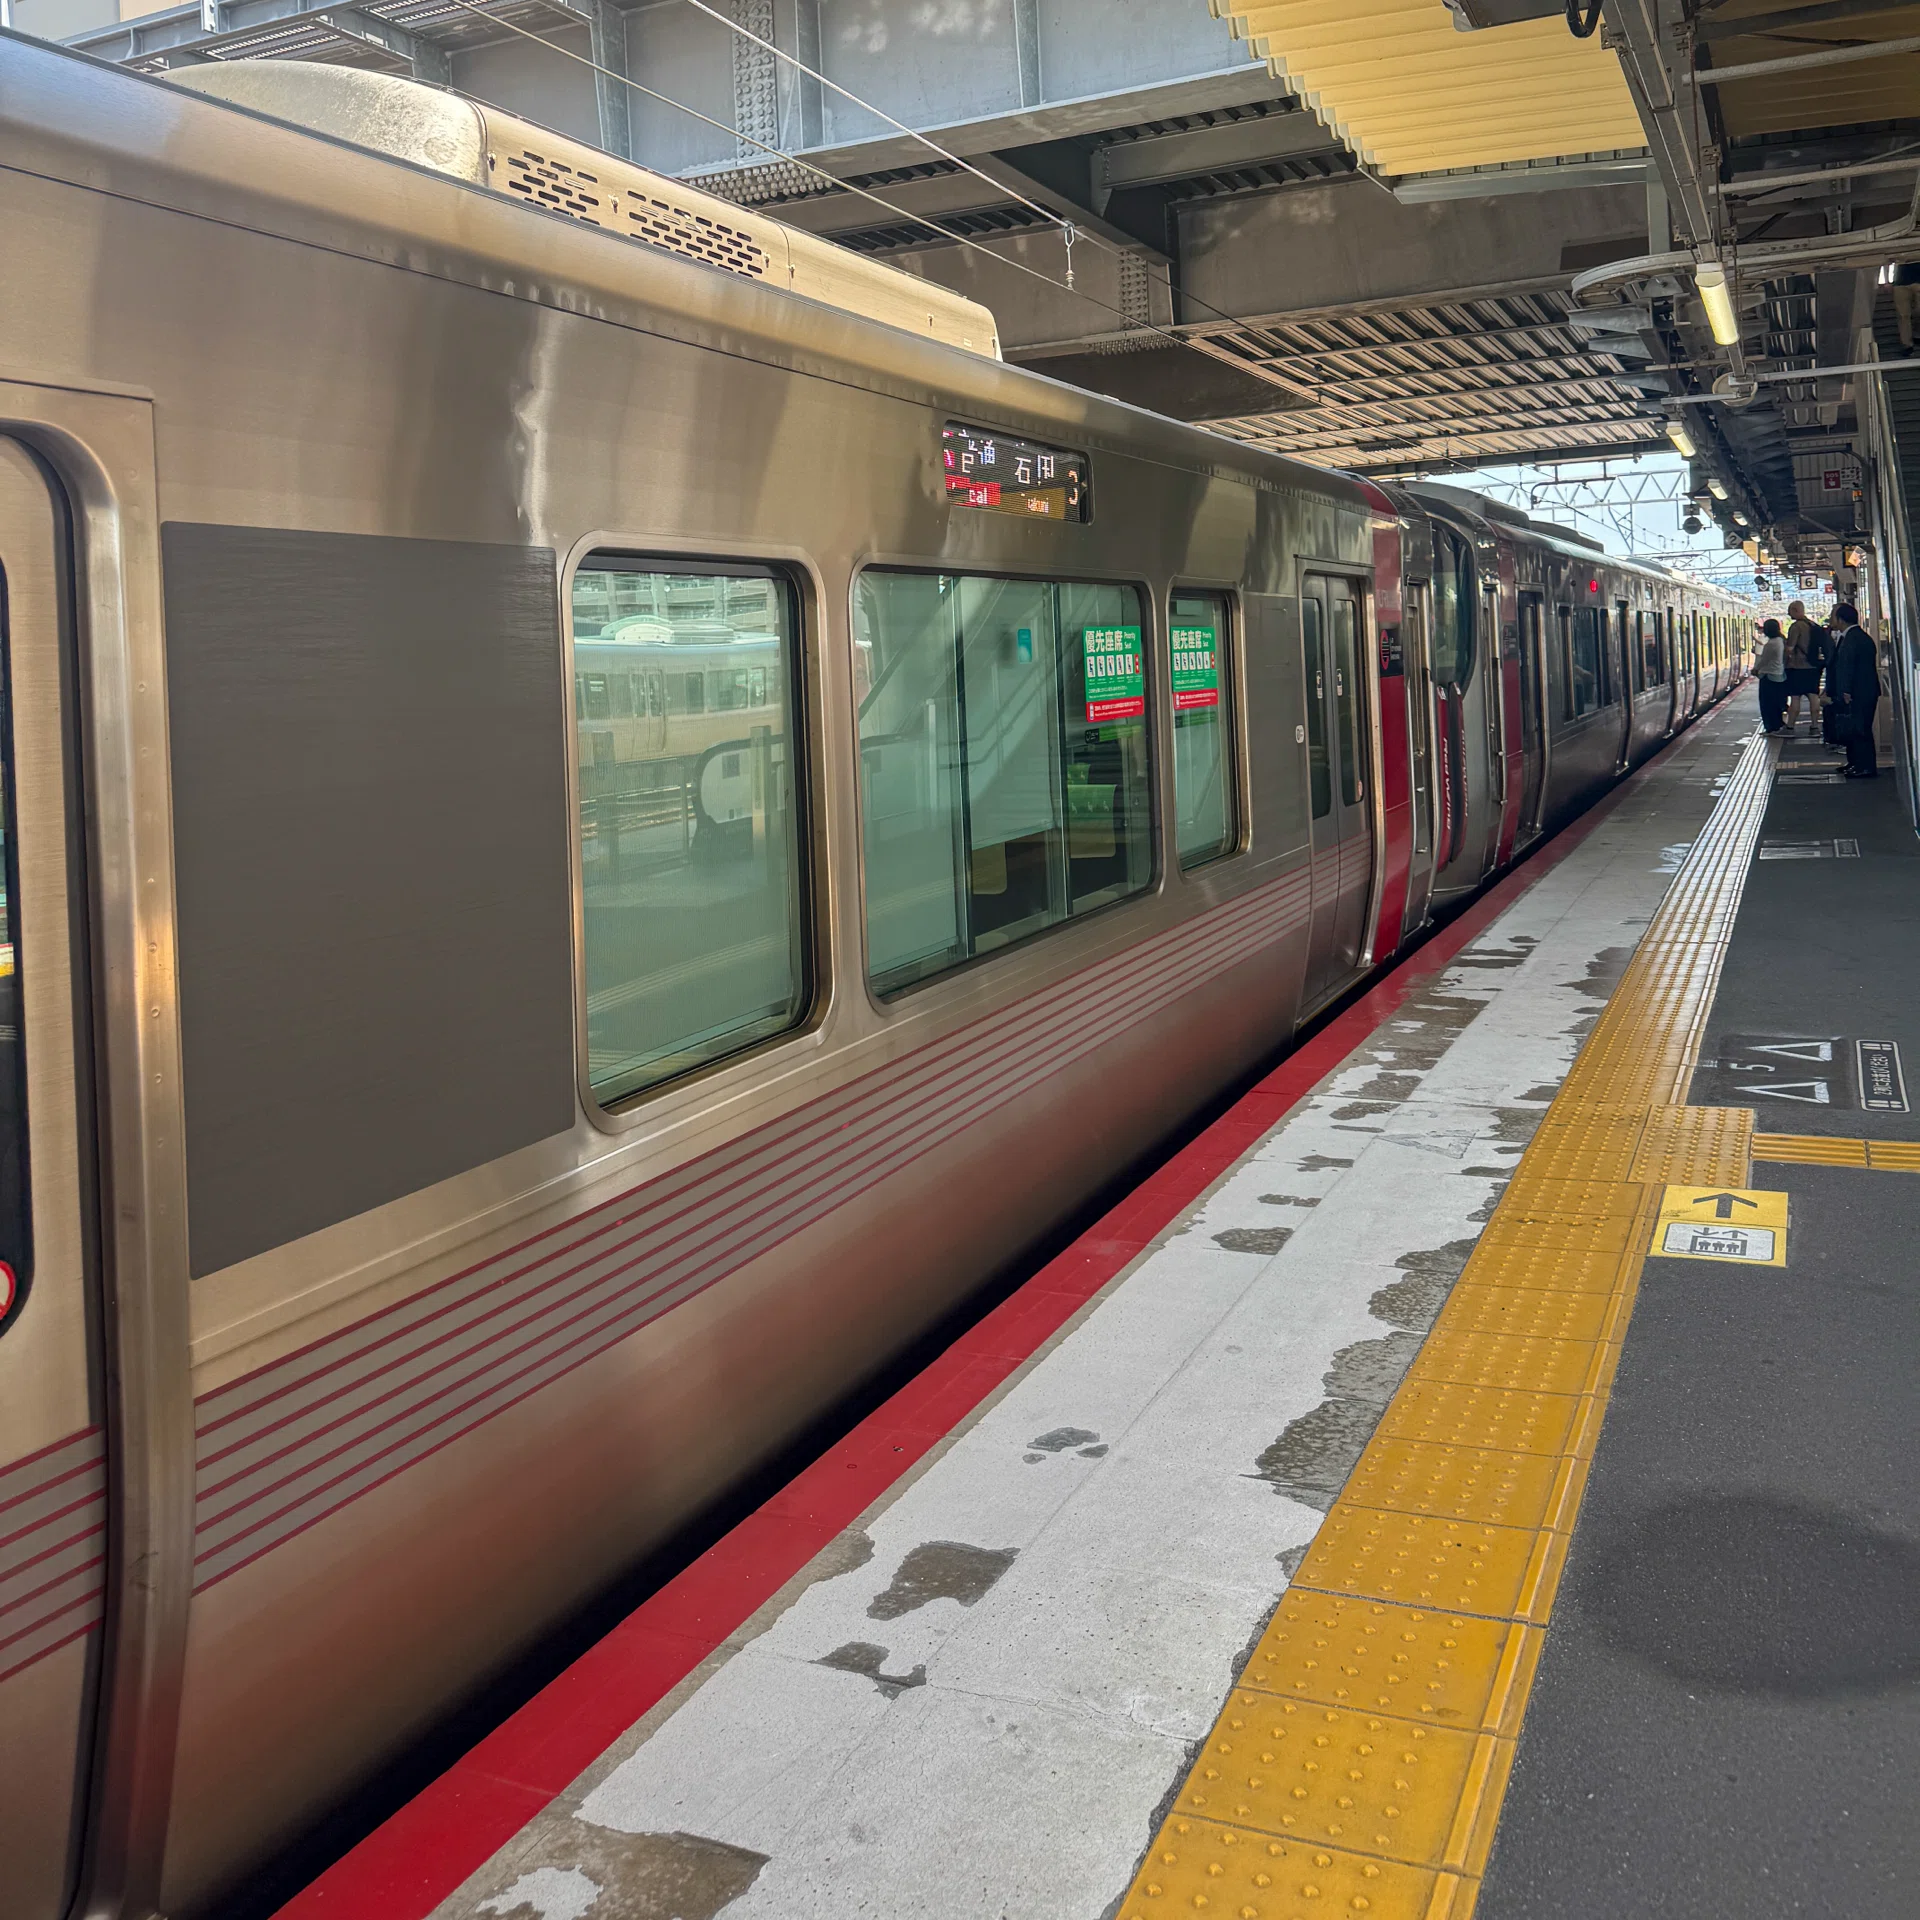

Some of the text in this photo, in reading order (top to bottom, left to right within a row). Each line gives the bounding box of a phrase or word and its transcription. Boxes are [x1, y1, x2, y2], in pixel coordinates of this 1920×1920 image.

[1729, 534, 1737, 545] 2
[1804, 577, 1813, 587] 6
[1085, 629, 1123, 653] 優先座席
[1172, 629, 1202, 650] 優先座席
[1730, 1063, 1776, 1073] 5
